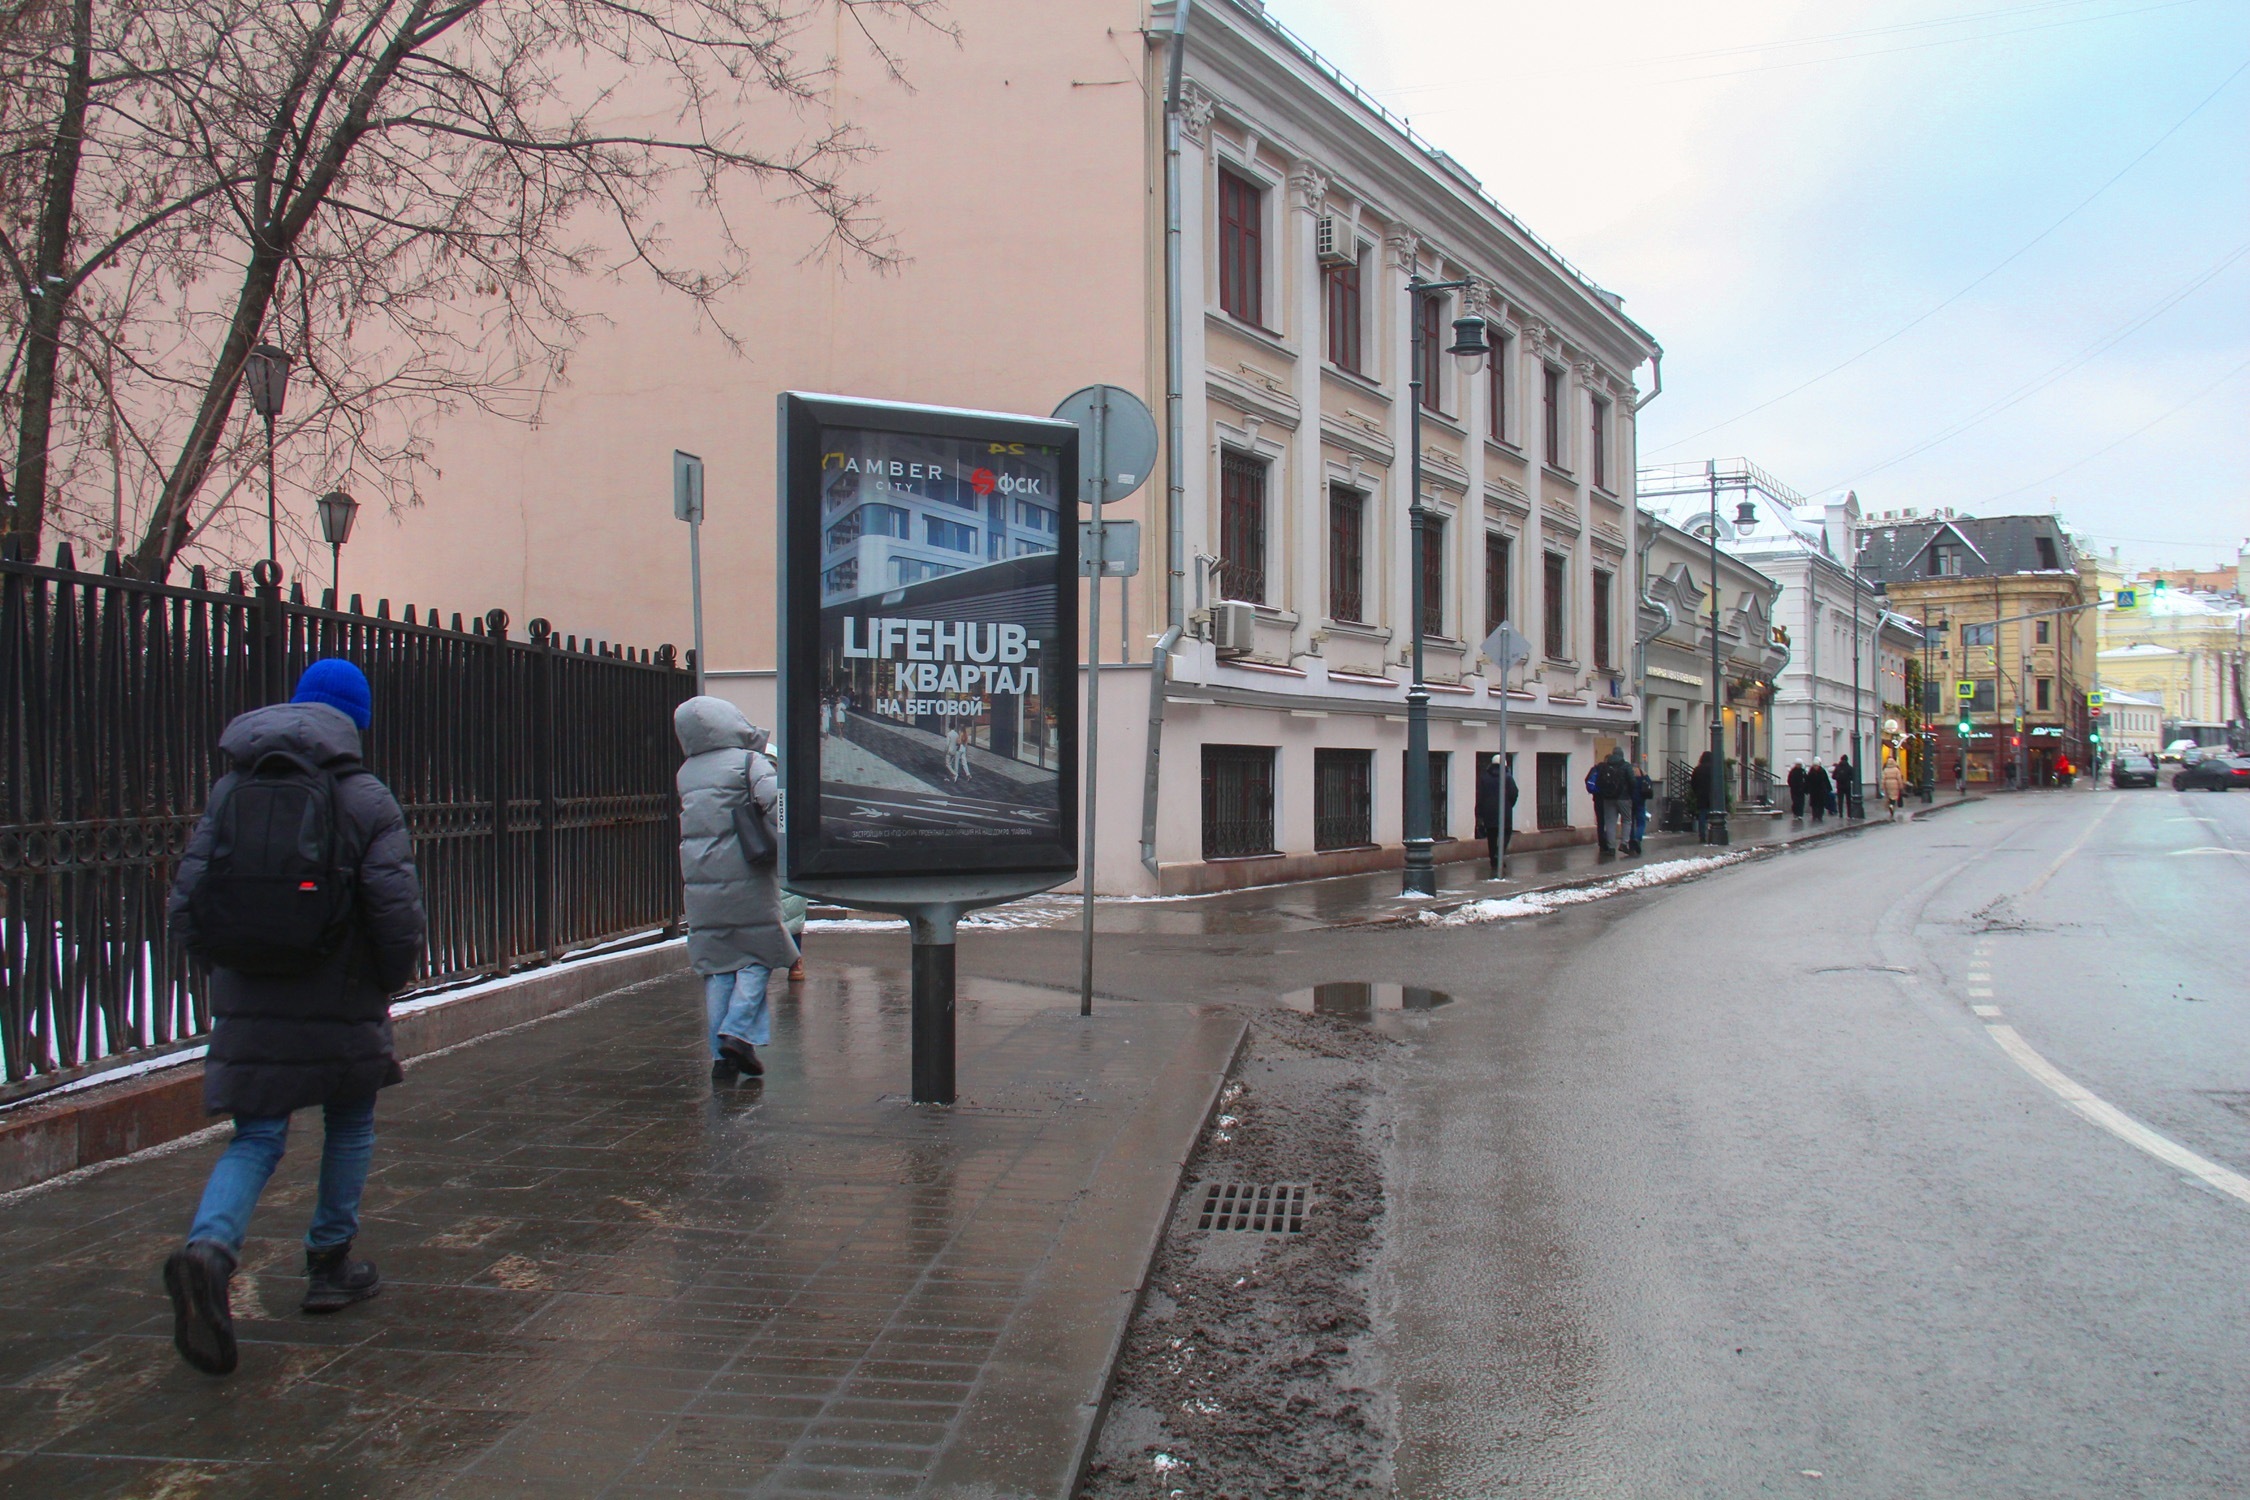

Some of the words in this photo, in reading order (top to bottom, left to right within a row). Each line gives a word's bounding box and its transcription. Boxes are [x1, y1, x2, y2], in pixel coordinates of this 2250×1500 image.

[844, 457, 943, 481] AMBER
[875, 481, 913, 493] CITY
[843, 616, 1040, 664] LIFEHUB-
[894, 662, 1039, 695] КВАРТАЛ
[876, 698, 905, 715] НА
[905, 696, 983, 716] БЕГОВОЙ
